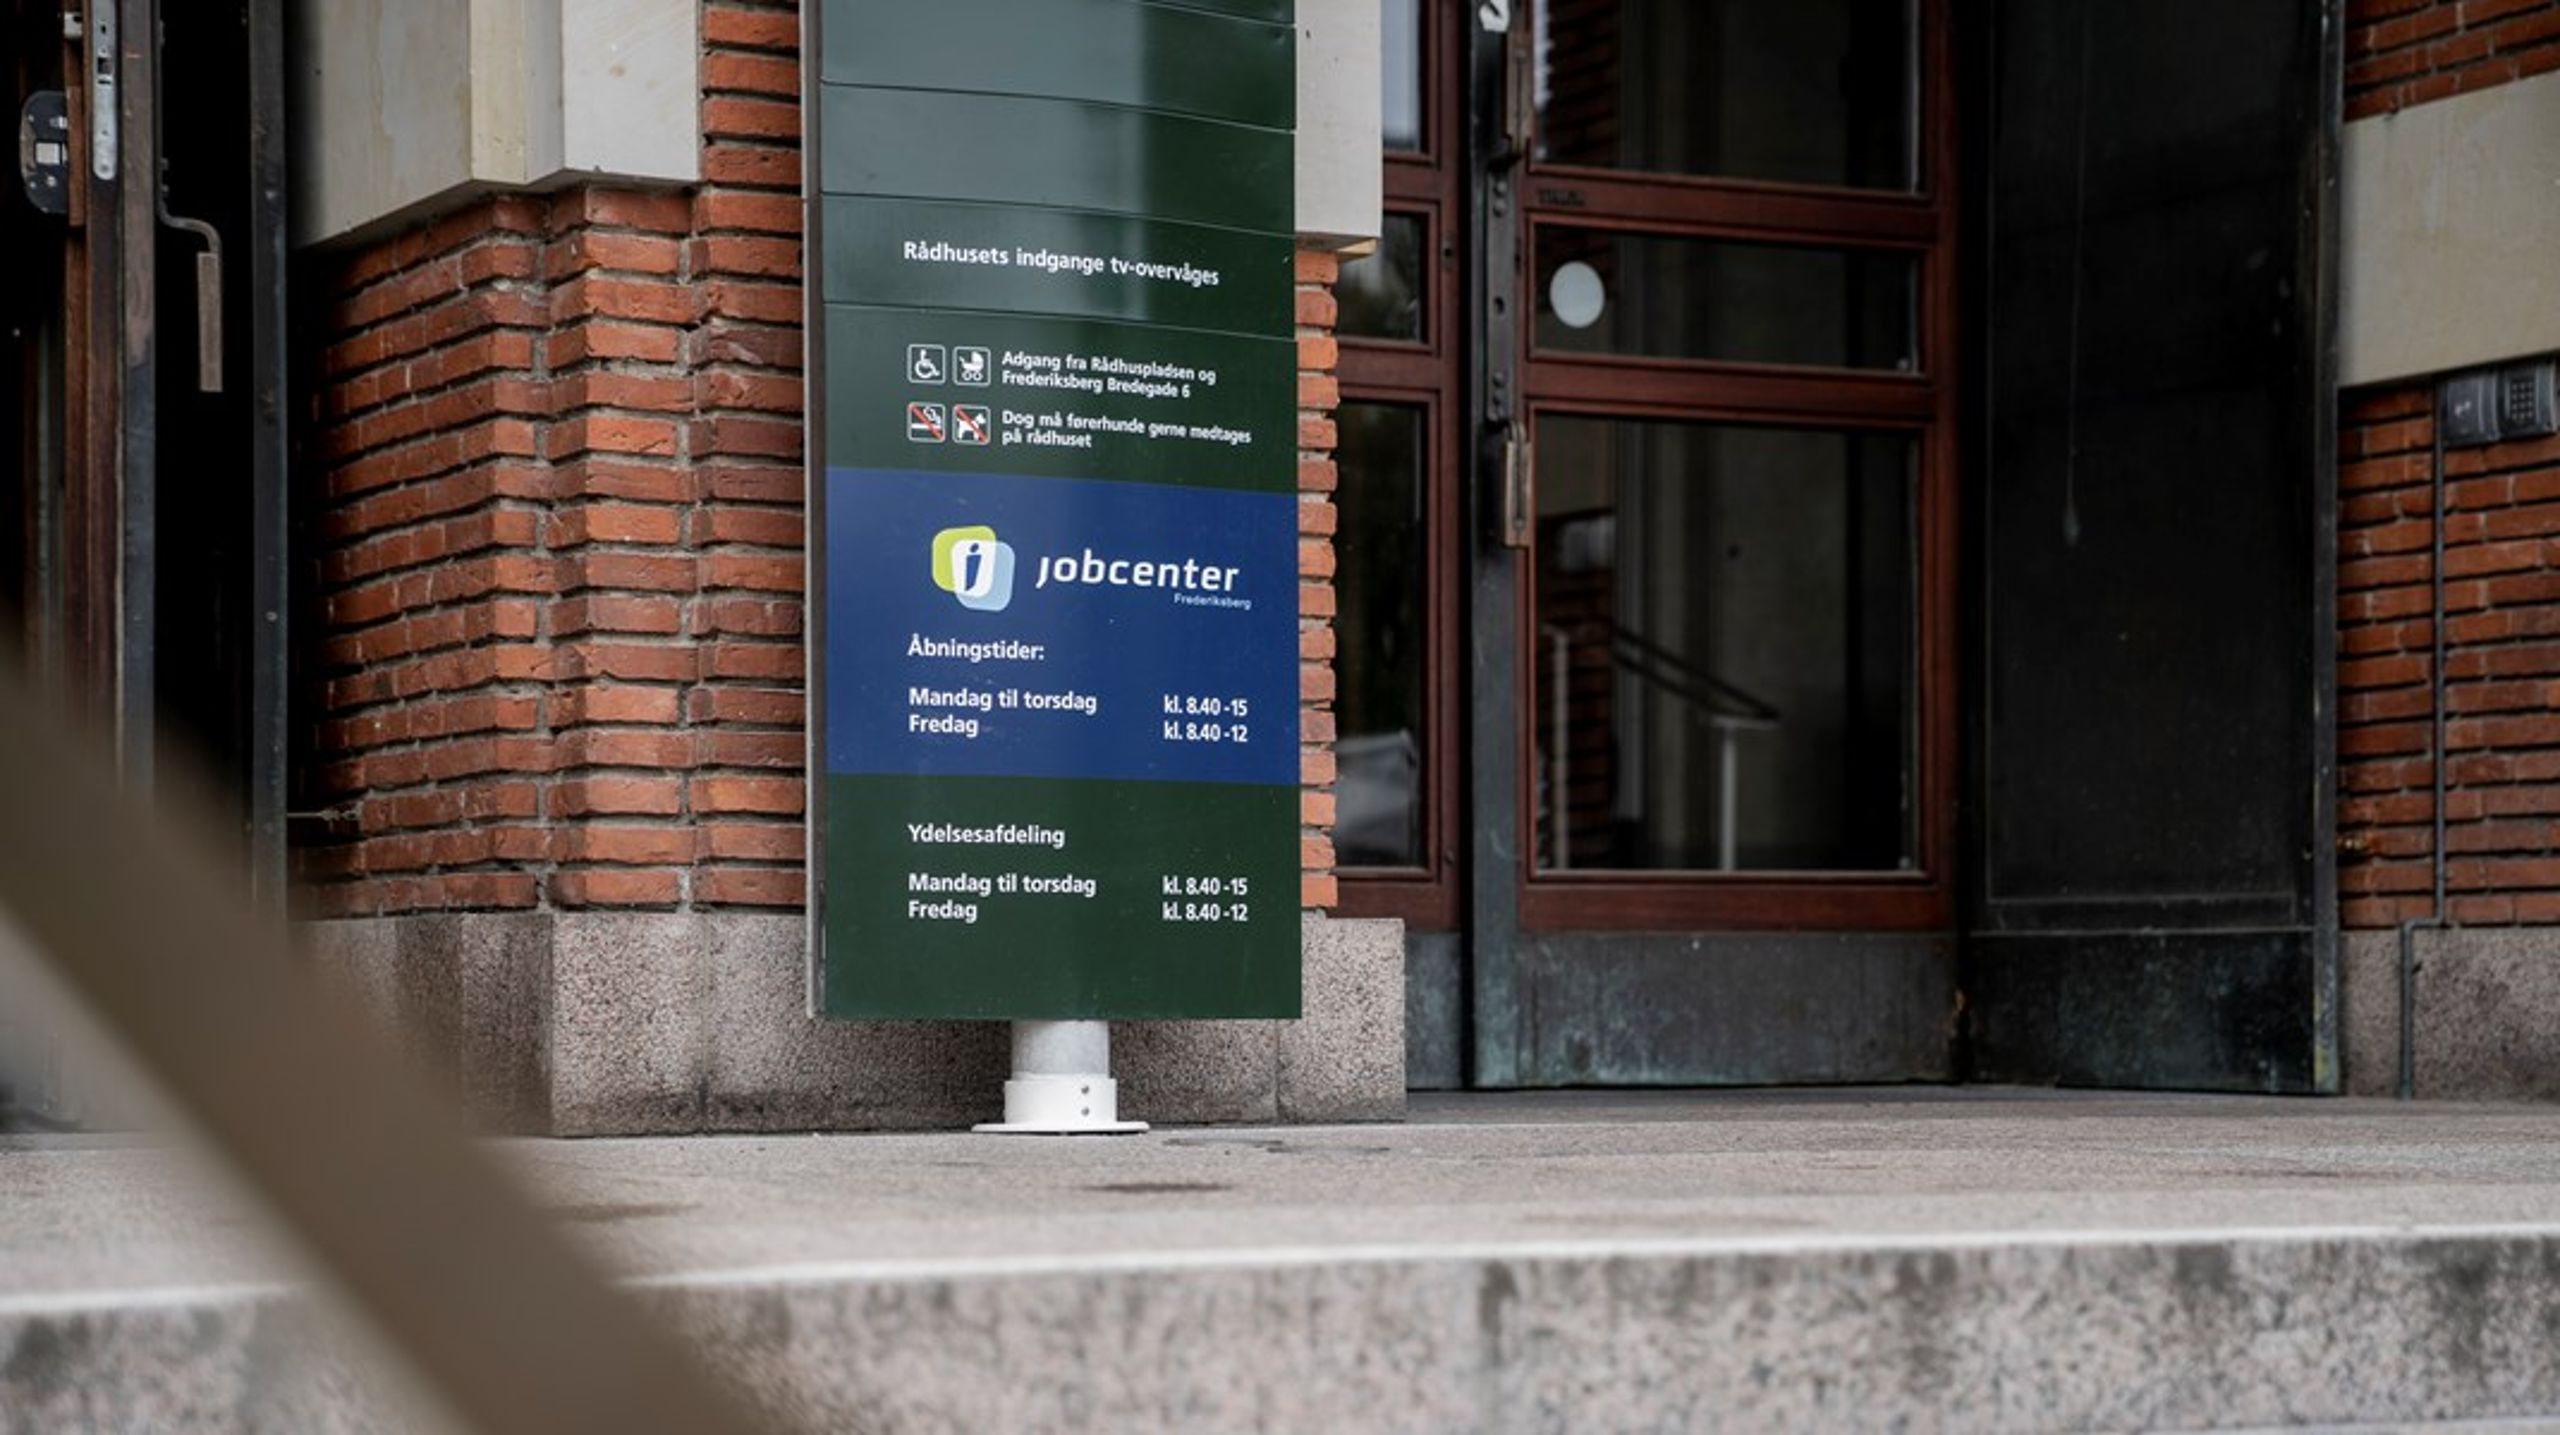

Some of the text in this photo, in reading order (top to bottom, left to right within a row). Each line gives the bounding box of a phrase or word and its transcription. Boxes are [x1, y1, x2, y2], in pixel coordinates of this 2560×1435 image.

[903, 240, 1219, 287] Rådhusets indgange tv-overvåges
[1001, 351, 1217, 386] Adgang fra Rådhuspladsen og
[1001, 370, 1191, 399] Frederiksberg Bredegade 6
[1001, 410, 1252, 445] Dog må førerhunde gerne medtages
[1001, 430, 1092, 448] på rådhuset
[1035, 548, 1239, 592] jobcenter
[1173, 591, 1252, 611] Frederiksberg
[907, 633, 1045, 662] Åbningstider:
[908, 687, 1097, 716] Mandag til torsdag
[1163, 695, 1184, 714] kl.
[908, 715, 979, 738] Fredag
[1163, 720, 1183, 740] kl.
[907, 823, 1066, 849] Ydelsesafdeling
[908, 872, 1097, 898] Mandag til torsdag
[1162, 875, 1183, 895] kl.
[908, 899, 978, 923] Fredag
[1162, 901, 1183, 920] kl.
